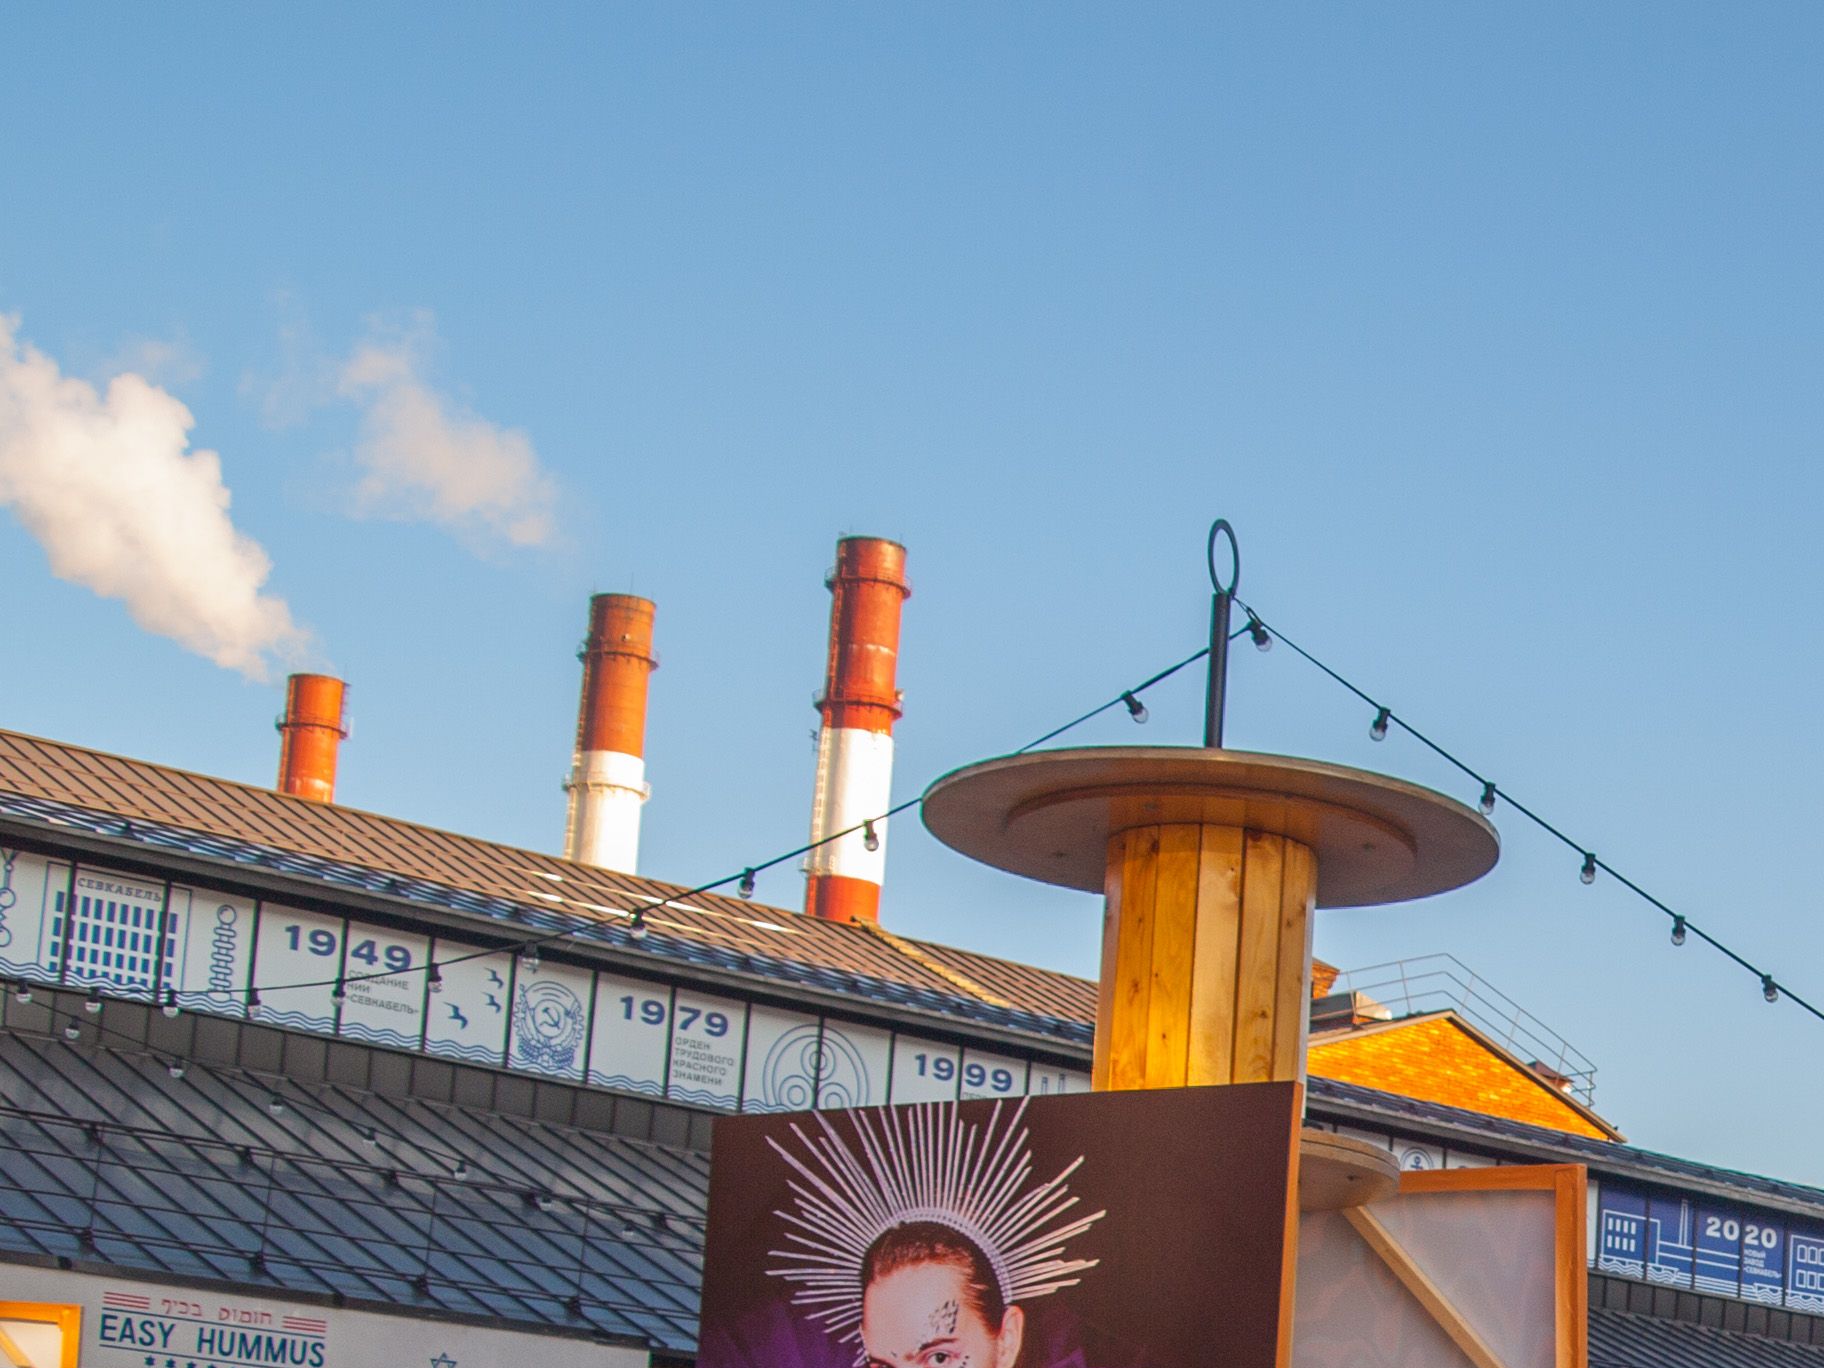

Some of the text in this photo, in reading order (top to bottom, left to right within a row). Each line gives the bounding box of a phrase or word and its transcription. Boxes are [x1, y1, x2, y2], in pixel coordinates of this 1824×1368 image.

[77, 877, 162, 903] СЕВКАБЕЛЬ
[284, 924, 412, 972] 1949
[620, 995, 729, 1037] 1979
[675, 1037, 711, 1051] ОРДЕН
[675, 1047, 735, 1067] ТРУДОВОГО
[673, 1059, 727, 1077] КРАСНОГО
[673, 1069, 723, 1086] ЗНАМЕНИ
[915, 1053, 1013, 1093] 1999
[1706, 1216, 1777, 1249] 2020
[100, 1314, 326, 1368] EASY HUMMUS
